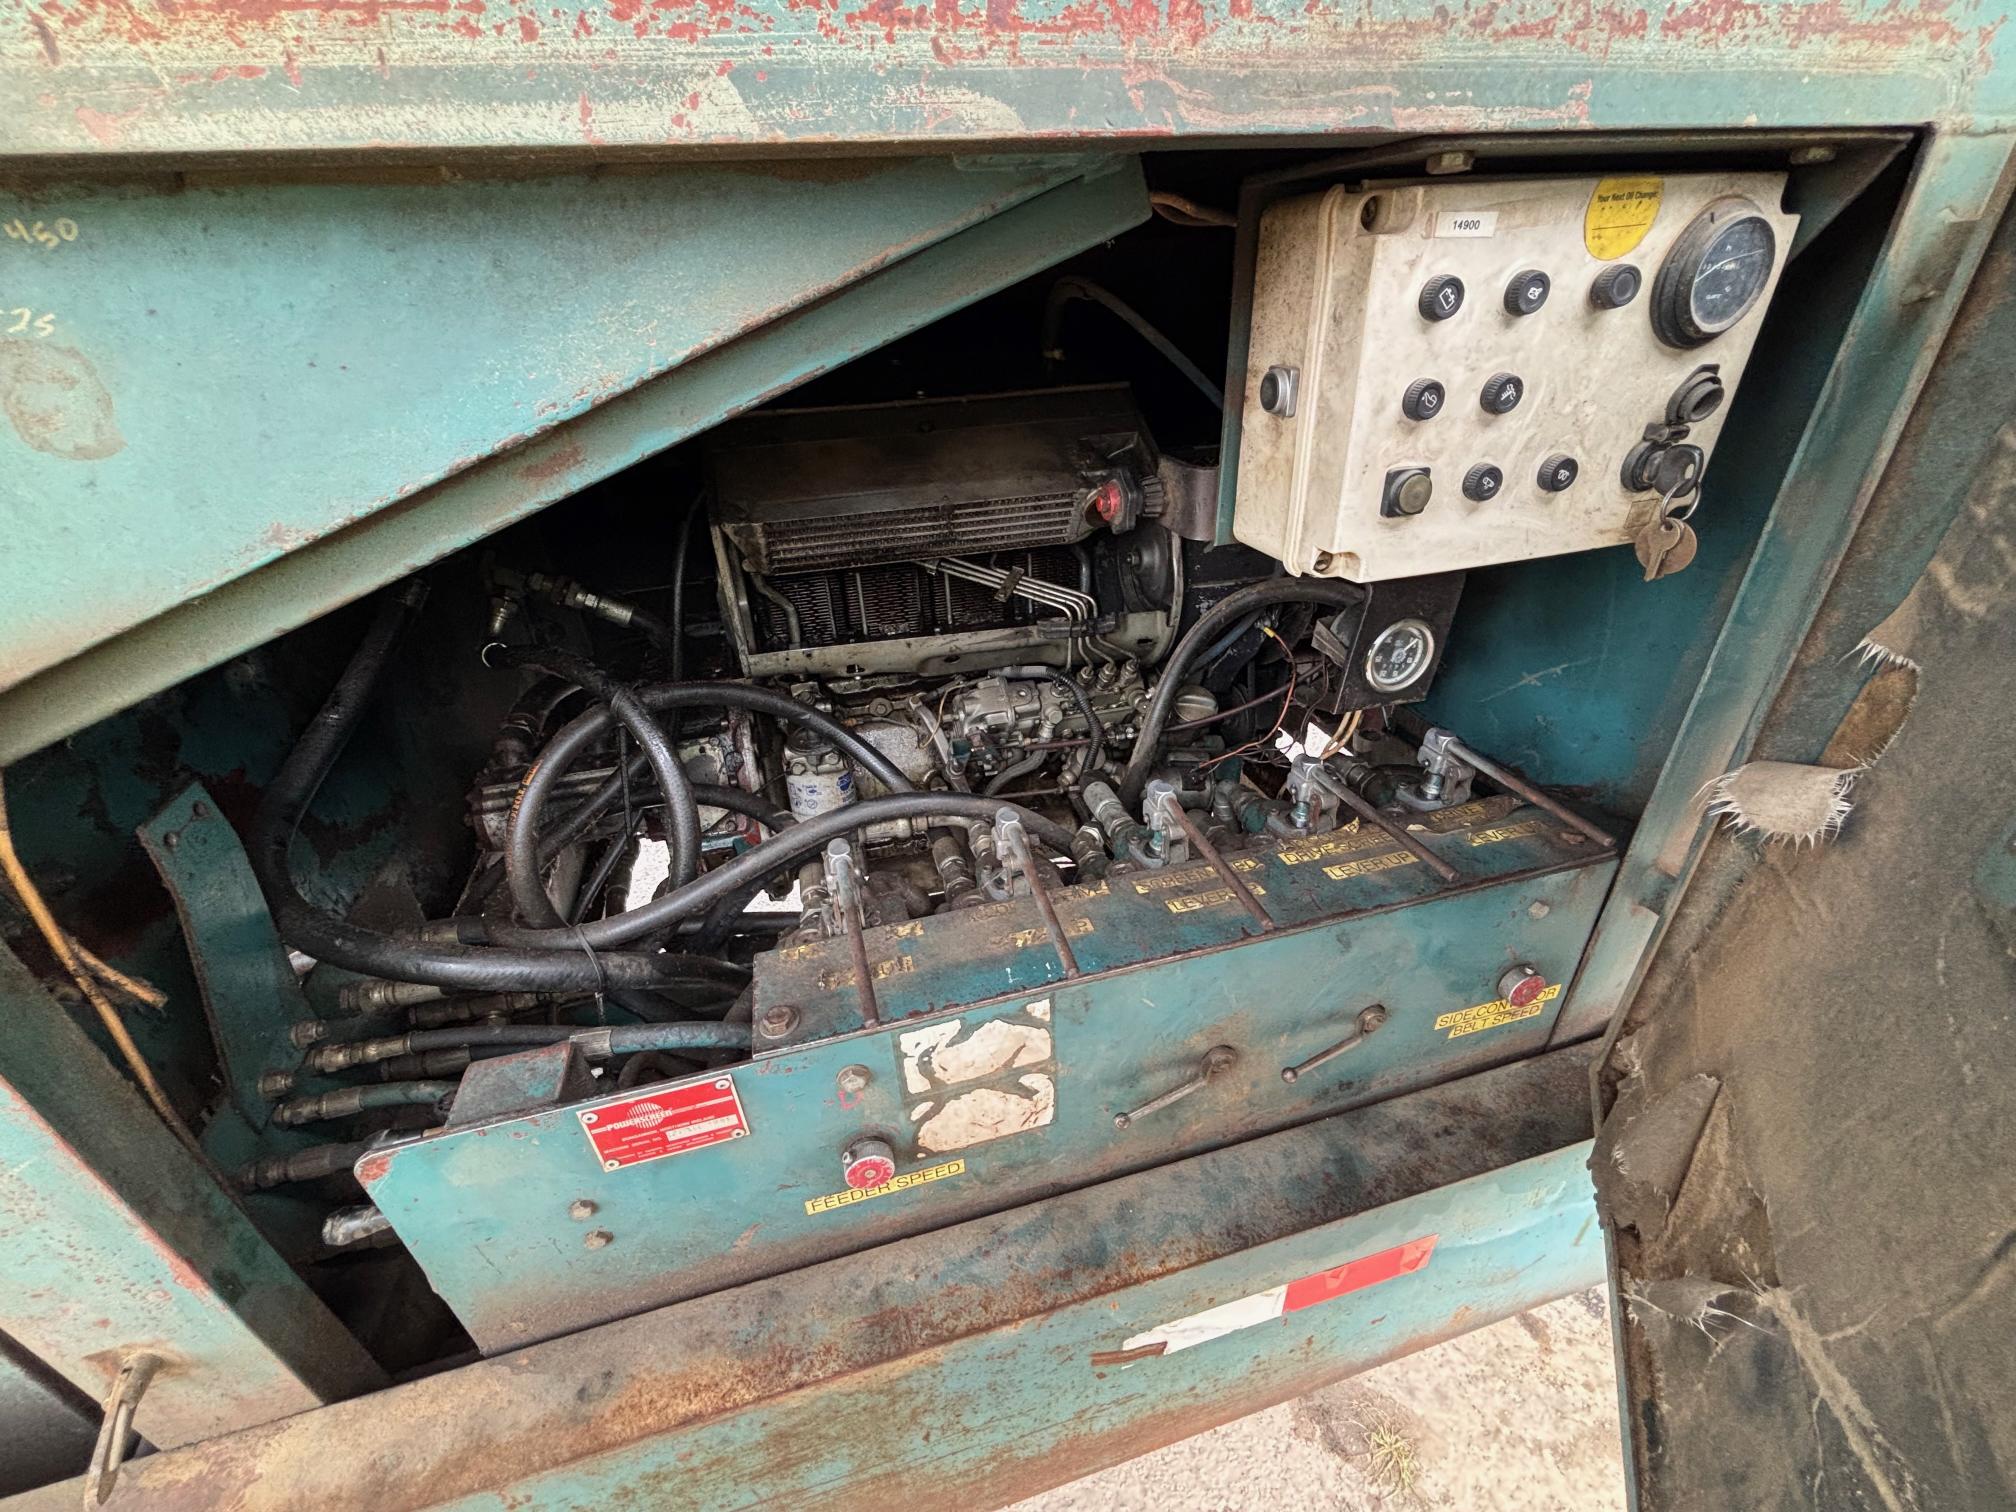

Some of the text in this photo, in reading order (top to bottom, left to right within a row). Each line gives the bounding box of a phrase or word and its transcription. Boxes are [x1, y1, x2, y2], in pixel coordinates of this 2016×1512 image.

[1453, 220, 1481, 230] 14900
[1472, 824, 1520, 845] LEVER
[1330, 851, 1412, 878] LEVER UP
[1169, 889, 1232, 911] LEVER
[1439, 987, 1557, 1027] SIDE CONOR
[1453, 1004, 1540, 1037] BELT SPEED
[811, 1161, 961, 1212] FEEDER SPEED
